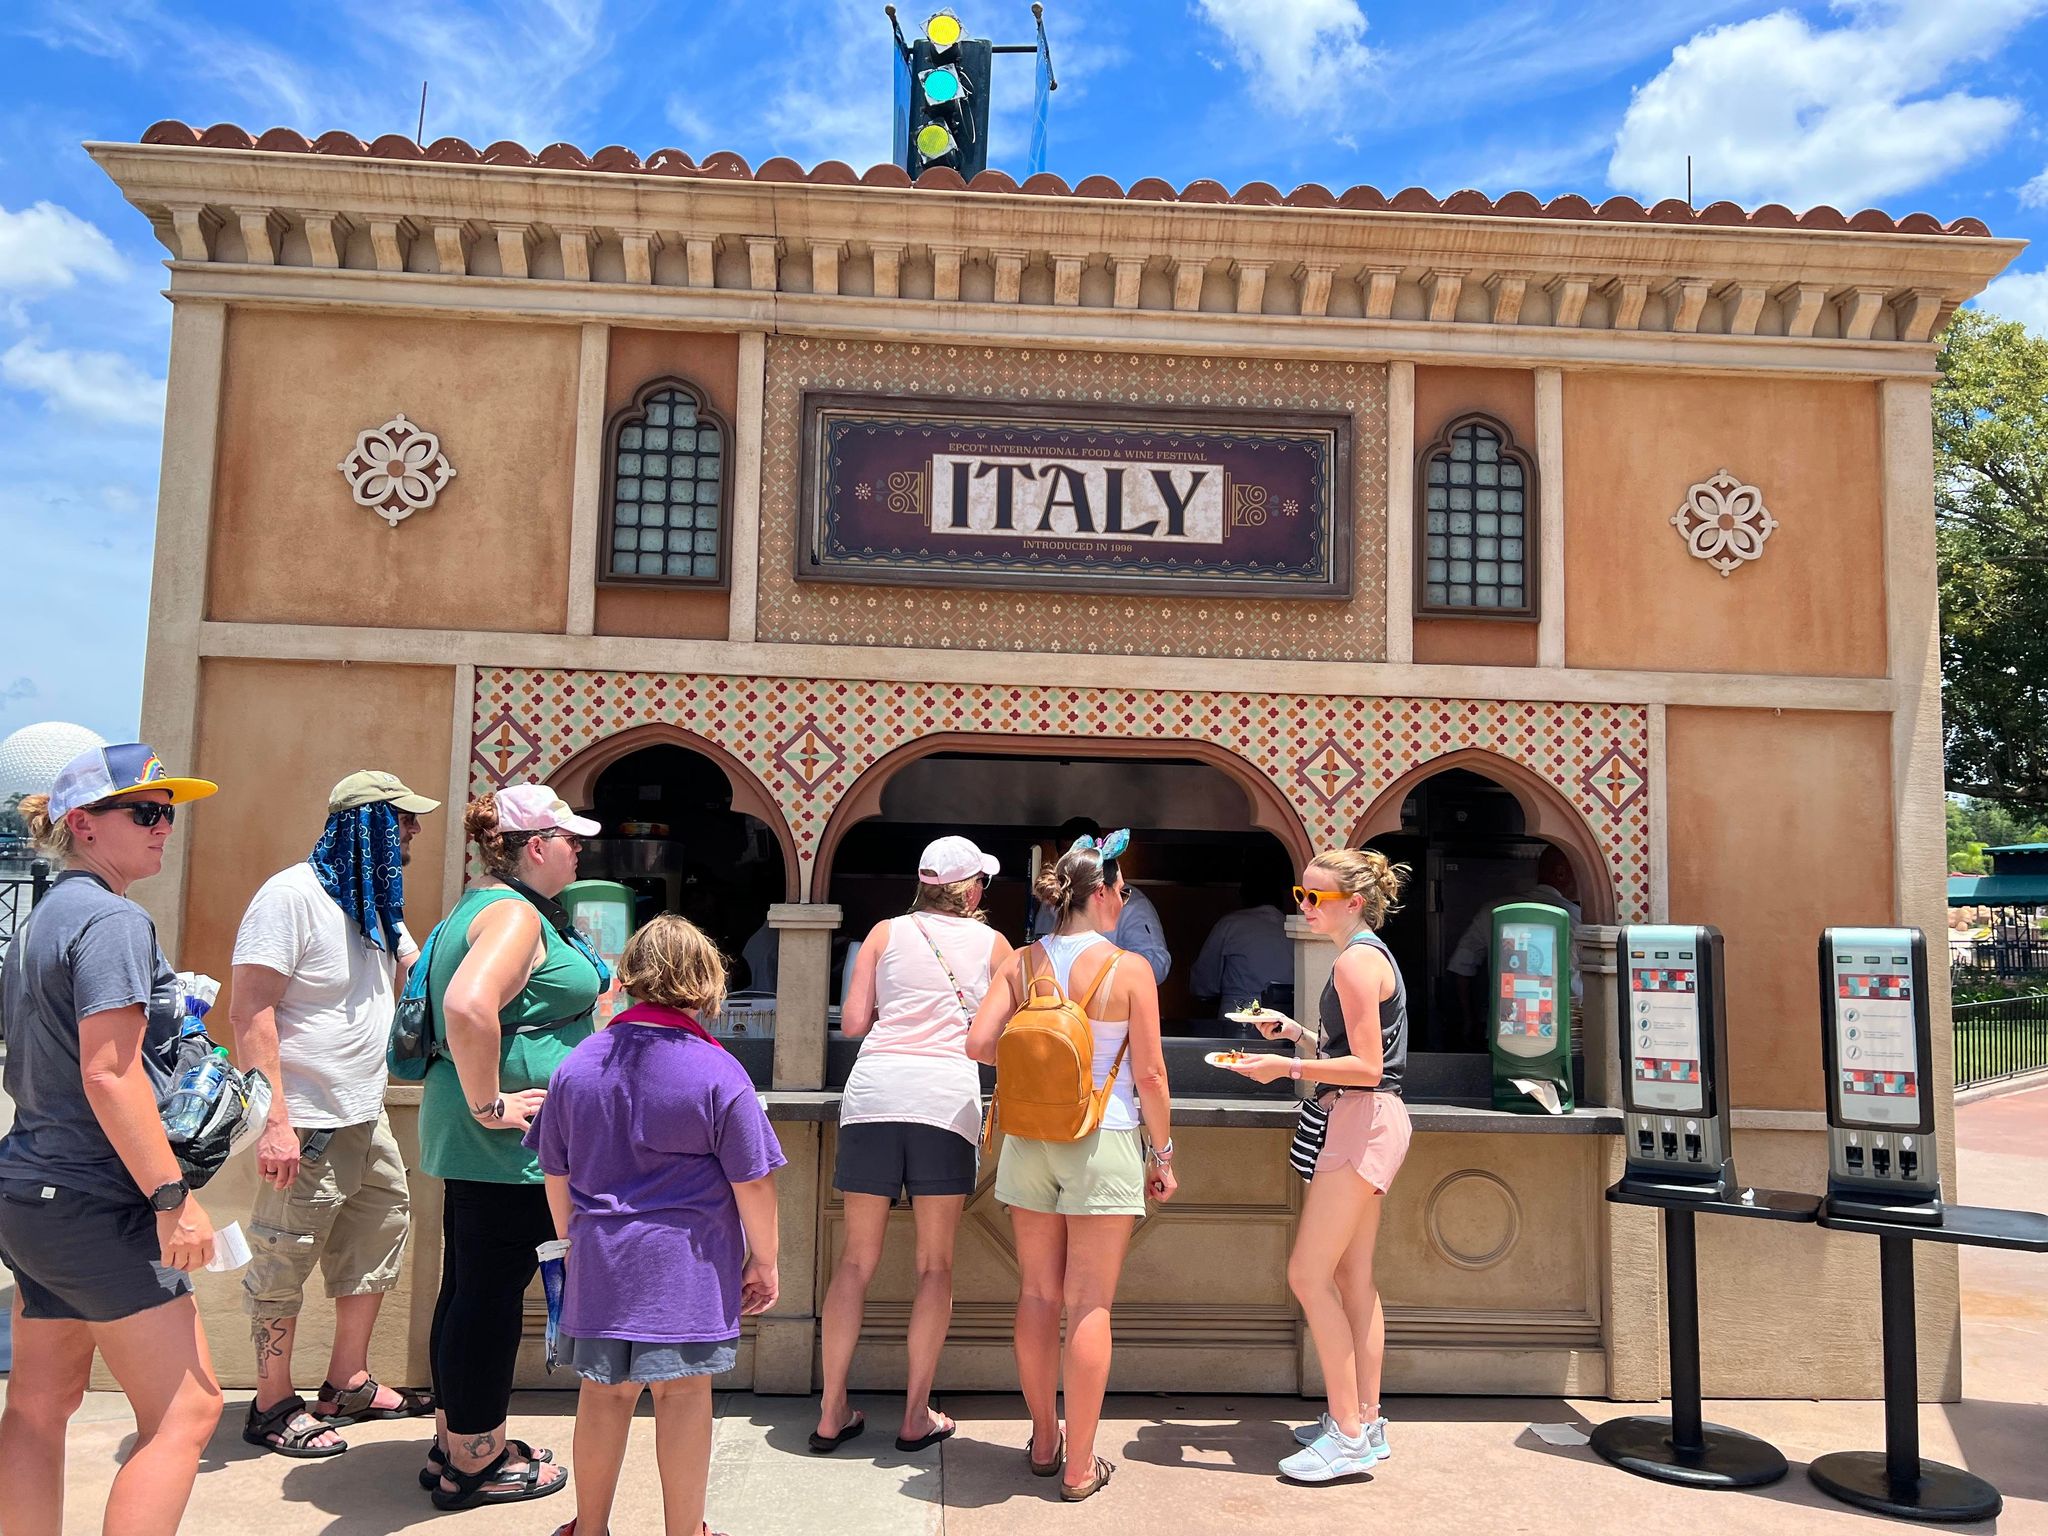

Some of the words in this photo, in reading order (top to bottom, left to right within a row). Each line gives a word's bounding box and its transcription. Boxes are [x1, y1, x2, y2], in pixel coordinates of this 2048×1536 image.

[990, 444, 1078, 456] INTERNATIONAL
[1082, 448, 1110, 457] FOOD
[1113, 449, 1121, 457] &
[1125, 450, 1153, 459] WINE
[1156, 451, 1207, 461] FESTIVAL
[949, 460, 1209, 537] ITALY
[1023, 540, 1093, 551] INTRODUCED
[1096, 543, 1108, 551] IN
